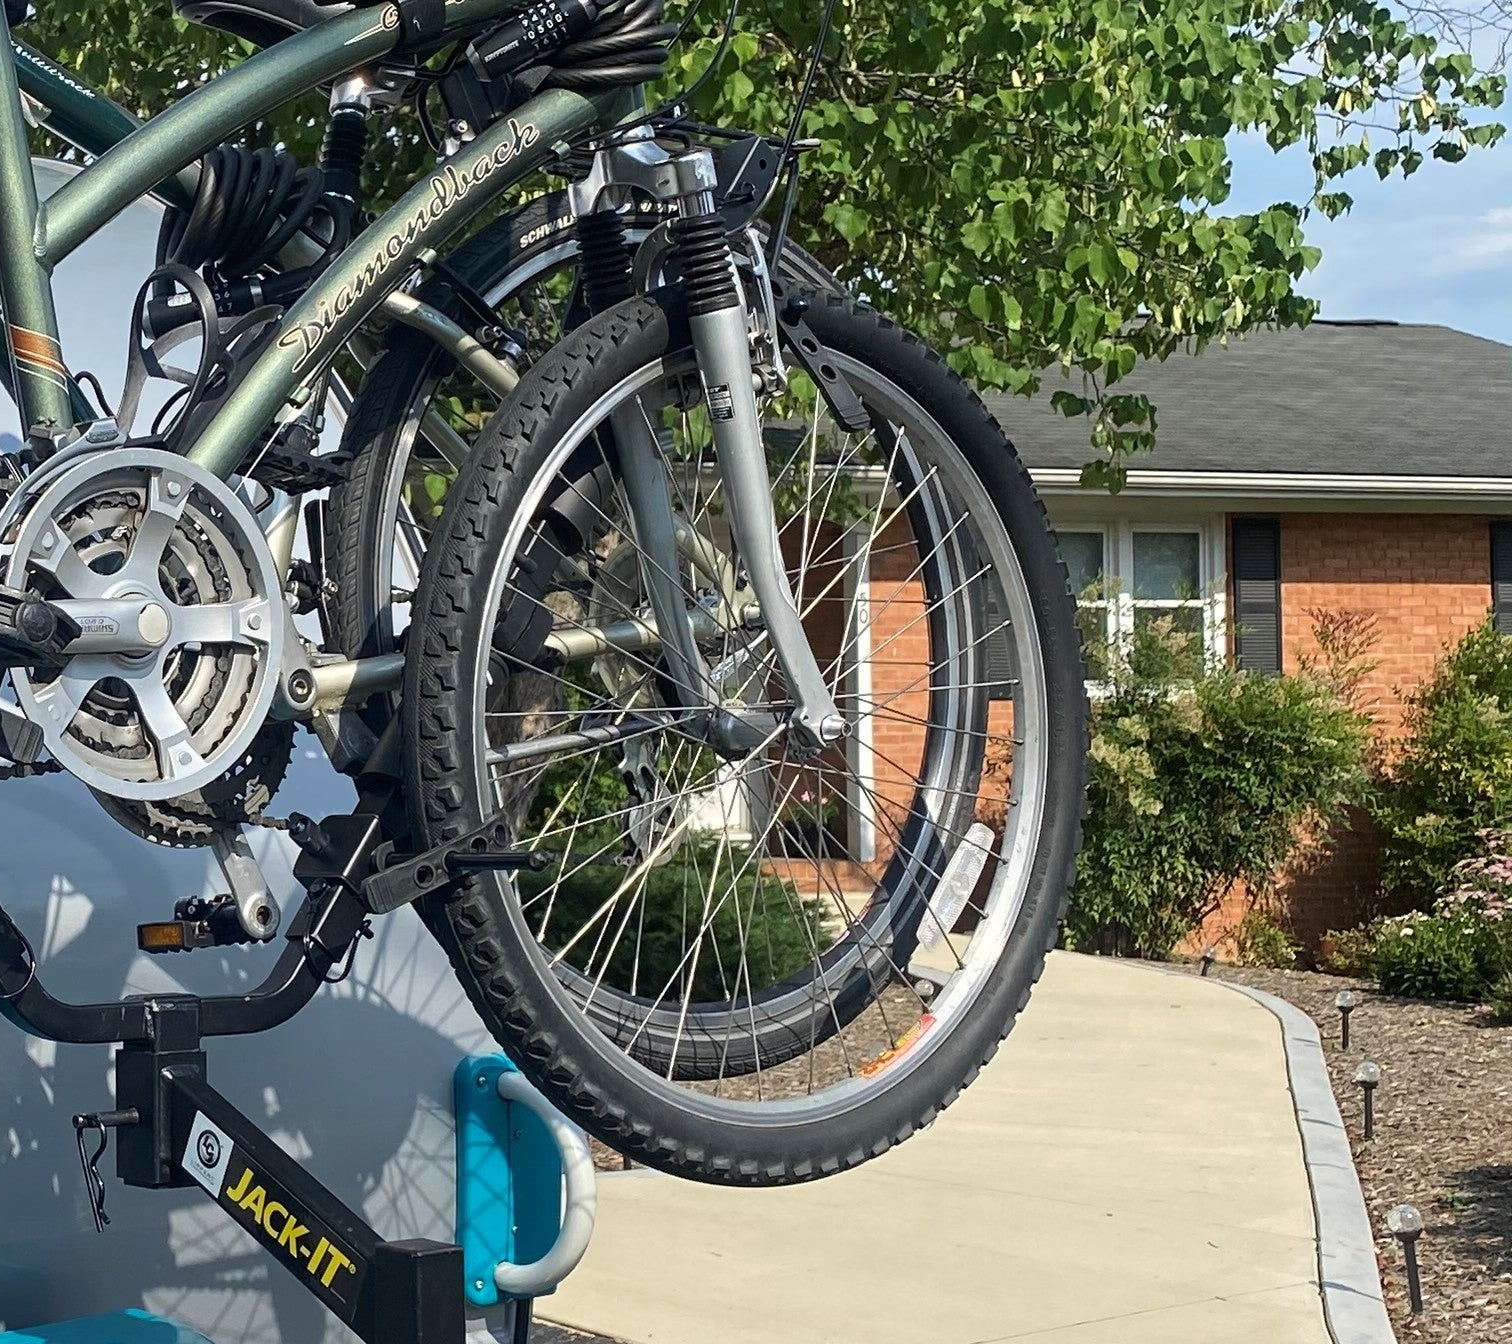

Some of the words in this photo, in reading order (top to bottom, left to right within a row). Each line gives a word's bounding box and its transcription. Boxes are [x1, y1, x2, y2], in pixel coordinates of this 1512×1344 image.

[276, 117, 540, 374] Diamondback
[519, 213, 578, 249] SCHWAL
[226, 1168, 350, 1288] JACK-IT
